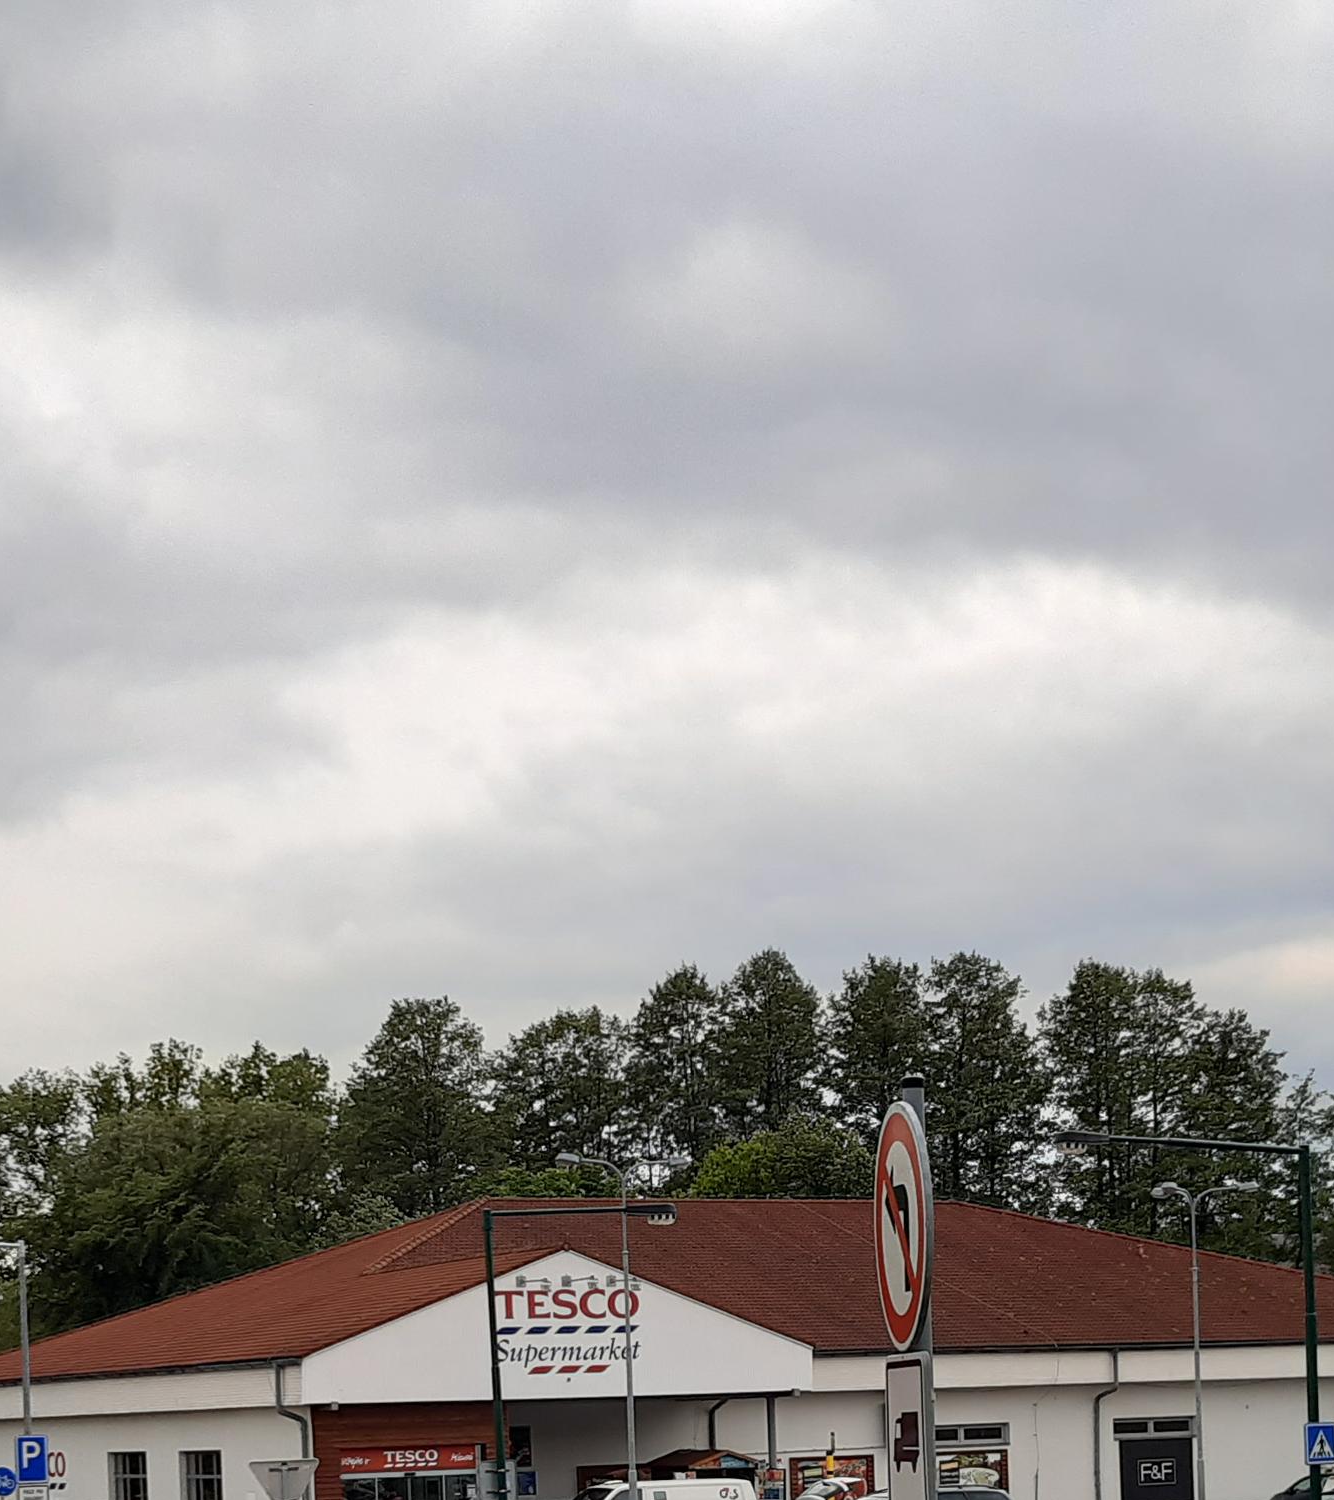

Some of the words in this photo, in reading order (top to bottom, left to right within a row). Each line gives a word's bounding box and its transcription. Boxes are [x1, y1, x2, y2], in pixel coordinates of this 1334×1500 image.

[494, 1288, 640, 1319] TESCO
[21, 1441, 41, 1469] P
[384, 1449, 438, 1463] TESCO
[1140, 1462, 1173, 1482] F&F
